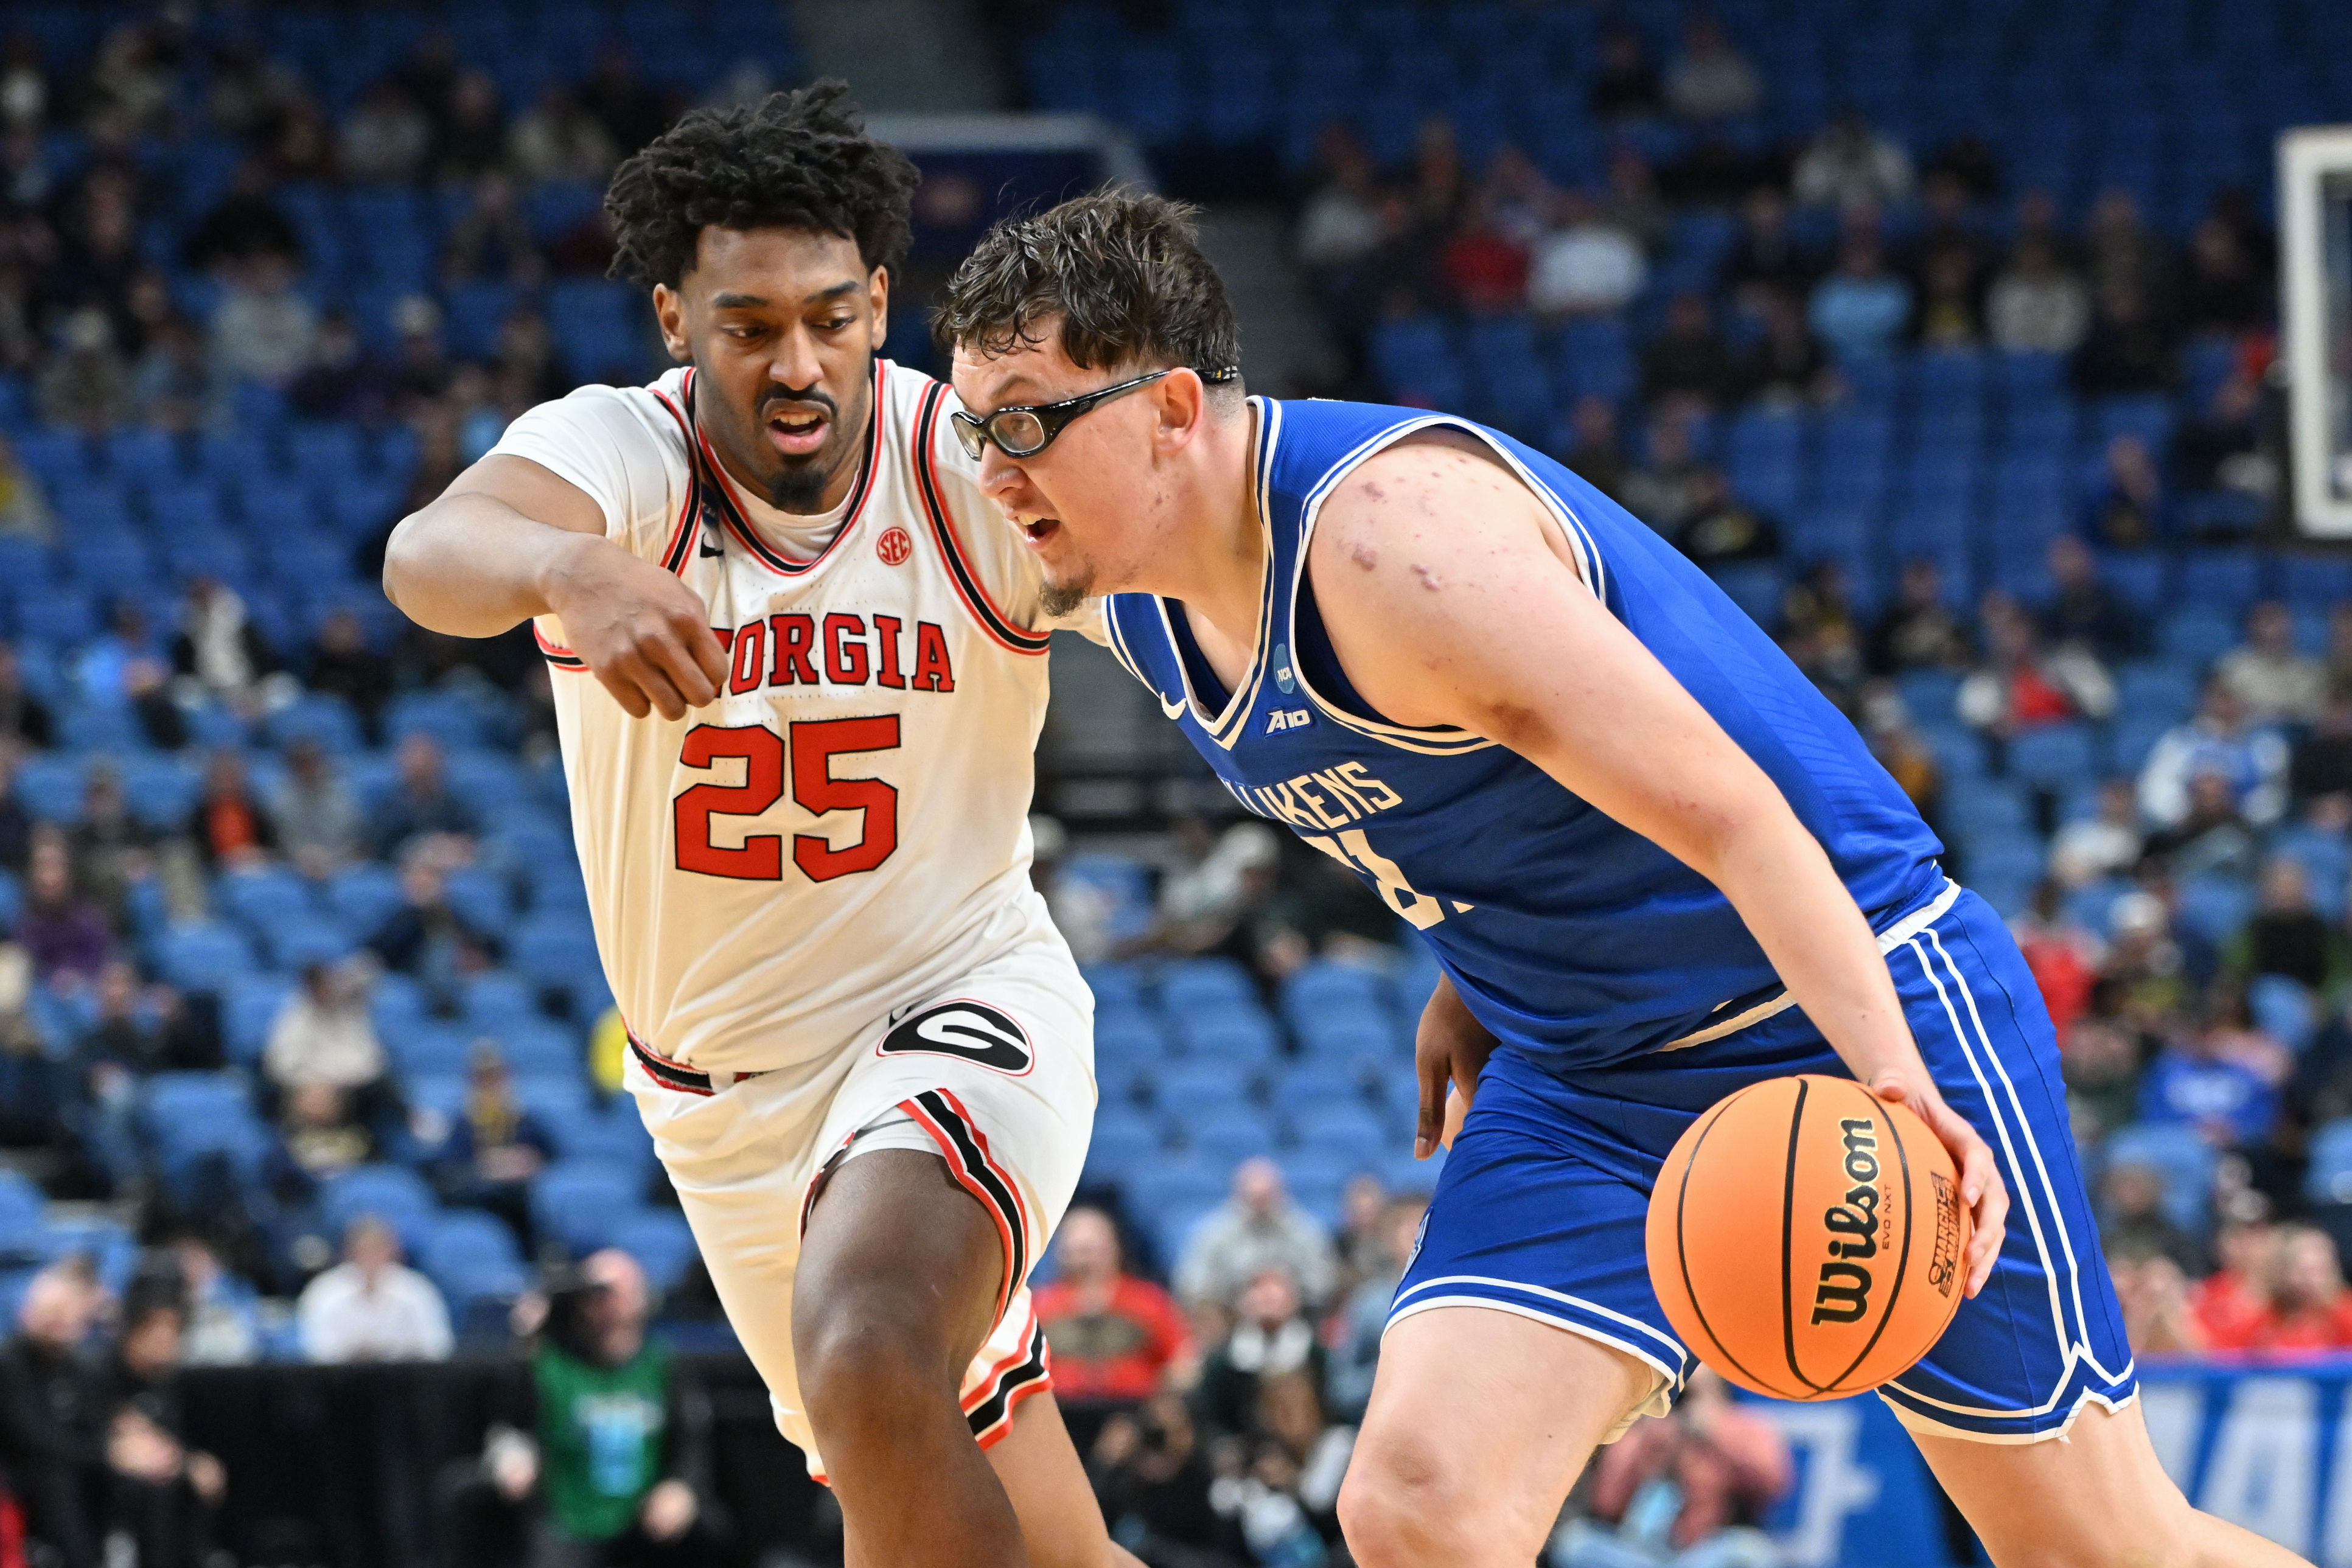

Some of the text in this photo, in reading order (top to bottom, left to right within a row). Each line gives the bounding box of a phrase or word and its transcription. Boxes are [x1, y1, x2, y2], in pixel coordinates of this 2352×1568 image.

[880, 531, 909, 561] SEC
[711, 612, 955, 698] ORGIA
[1266, 709, 1311, 734] A10
[674, 714, 901, 883] 25
[1810, 1118, 1880, 1326] Wilson
[1882, 1219, 1891, 1250] EVO
[1934, 1202, 1949, 1266] MARCH
